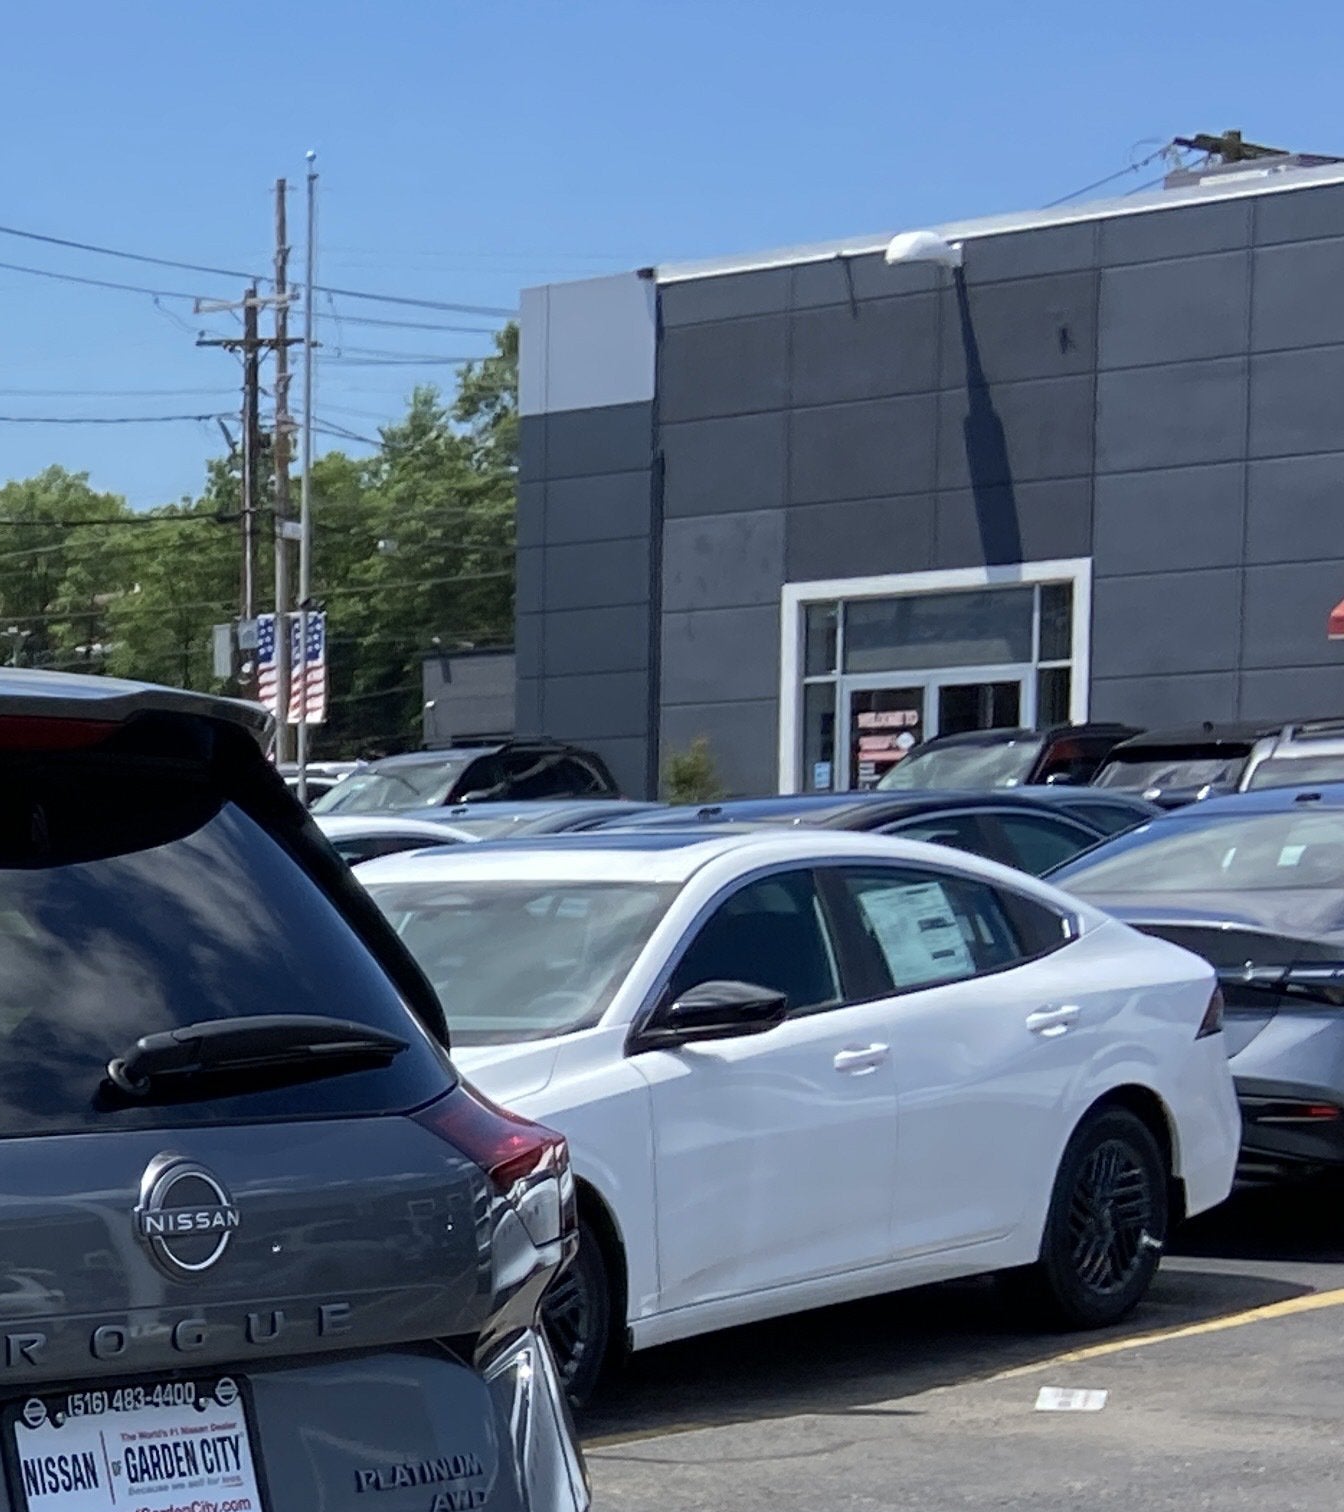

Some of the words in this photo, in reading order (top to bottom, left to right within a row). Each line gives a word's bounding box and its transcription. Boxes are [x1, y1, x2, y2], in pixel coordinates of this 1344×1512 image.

[144, 1209, 241, 1235] NISSAN
[4, 1302, 353, 1368] ROGUE
[67, 1392, 109, 1416] (516)
[112, 1382, 195, 1412] 483-4400
[120, 1432, 136, 1441] The
[23, 1451, 99, 1497] NISSAN
[124, 1440, 200, 1483] GARDEN
[200, 1434, 241, 1475] CITY
[354, 1453, 483, 1493] PLATINUM
